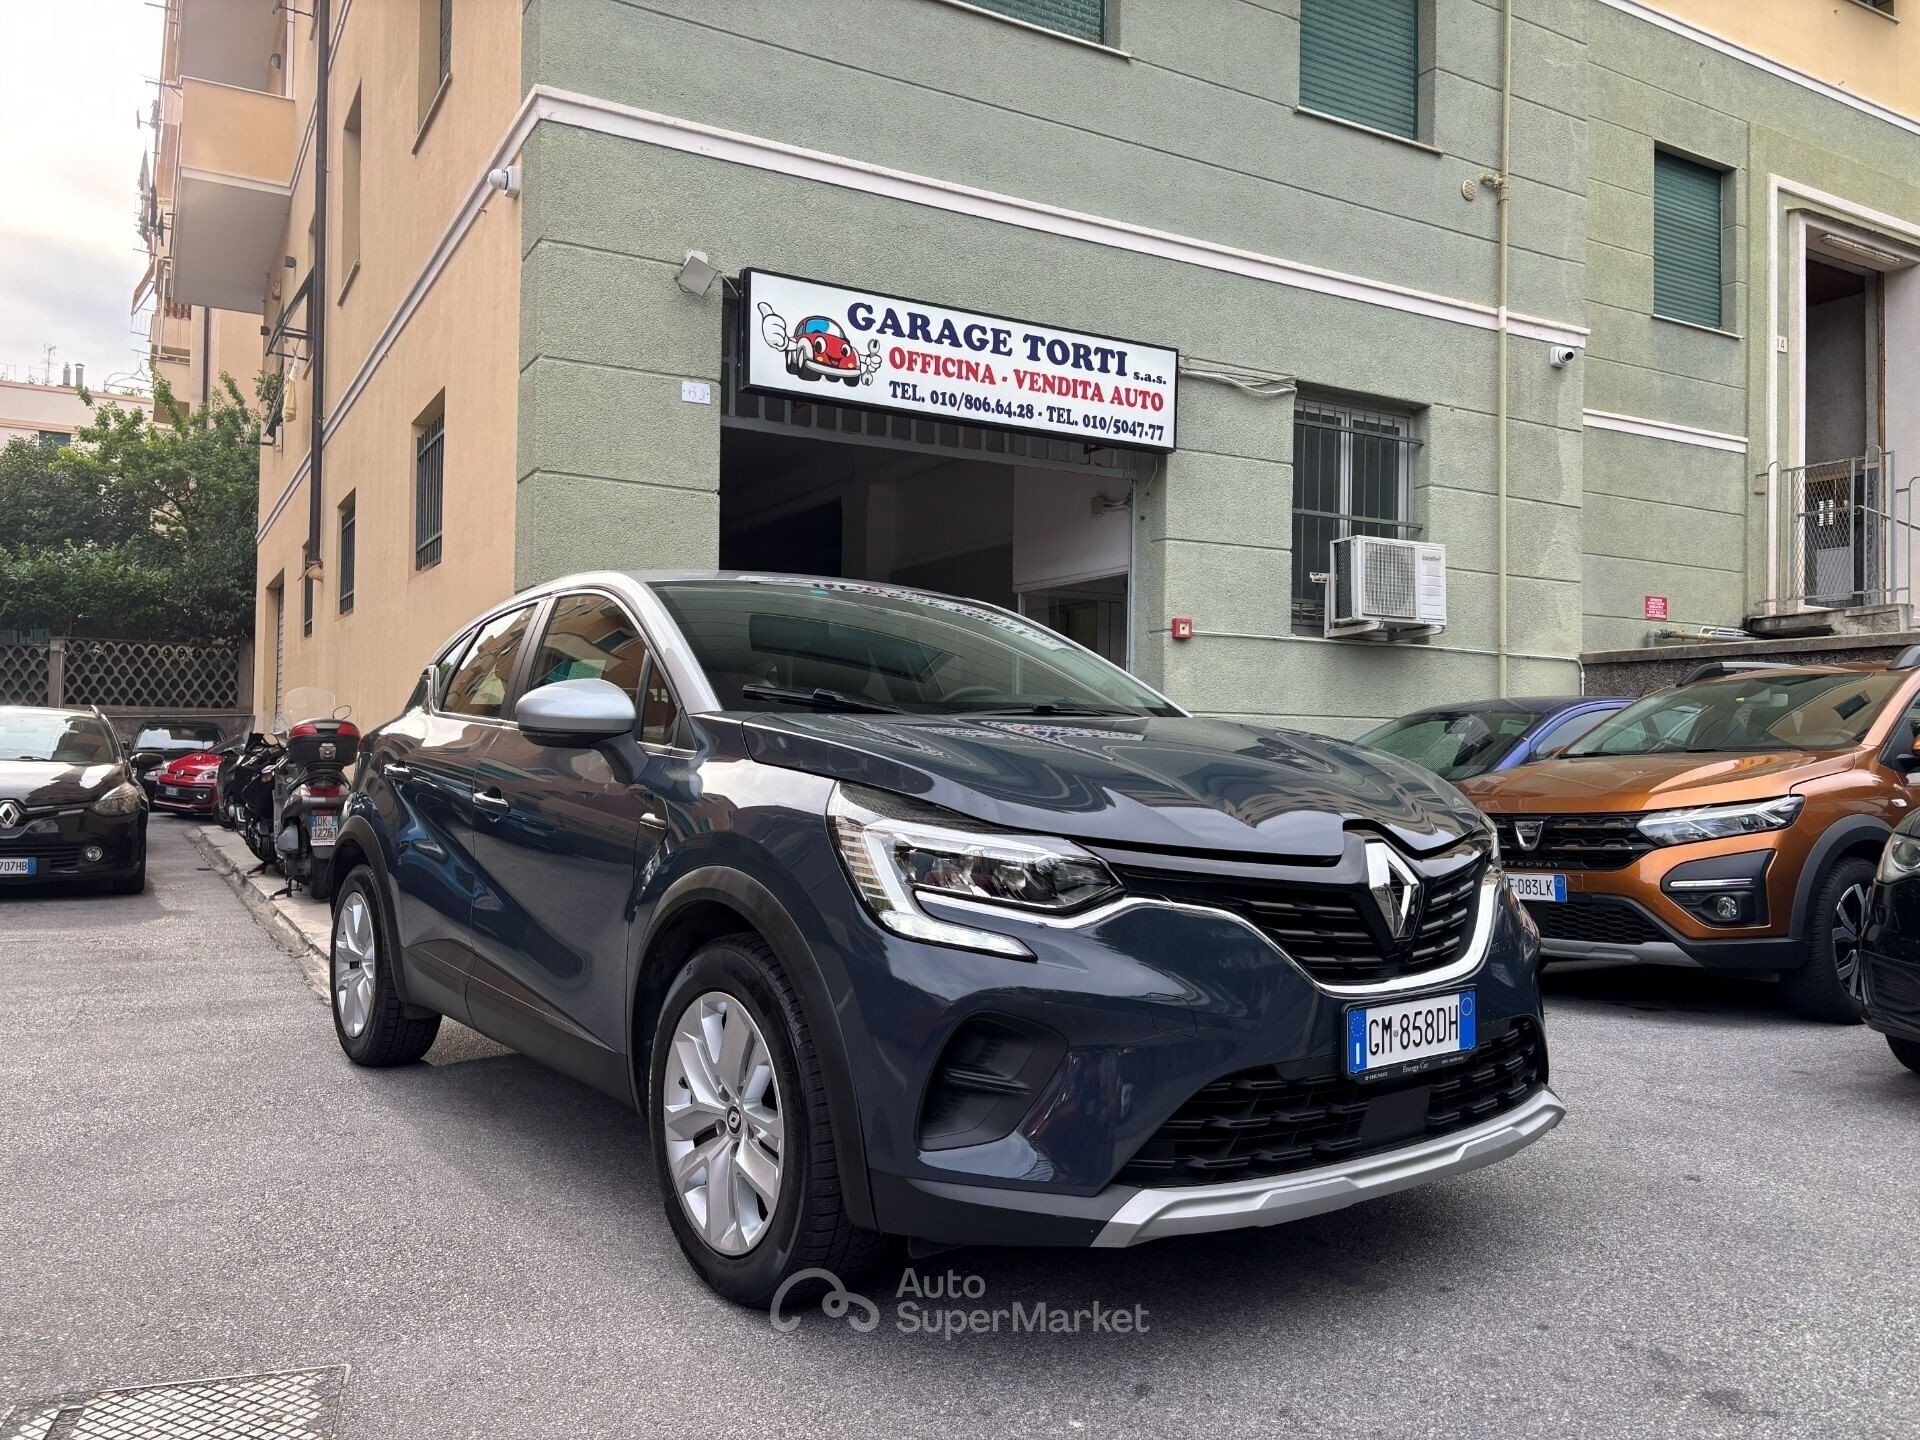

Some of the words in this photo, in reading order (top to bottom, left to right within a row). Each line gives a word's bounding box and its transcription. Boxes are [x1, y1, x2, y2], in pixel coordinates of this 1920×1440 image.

[847, 302, 1013, 357] GARAGE
[1022, 333, 1128, 377] TORTI
[1133, 371, 1167, 385] s.a.s.
[889, 346, 996, 385] OFFICINA
[1013, 369, 1105, 402] VENDITA
[1110, 385, 1164, 412] AUTO
[889, 380, 925, 403] TEL.
[930, 390, 1034, 419] 010/806.64.28
[1046, 405, 1079, 427] TEL.
